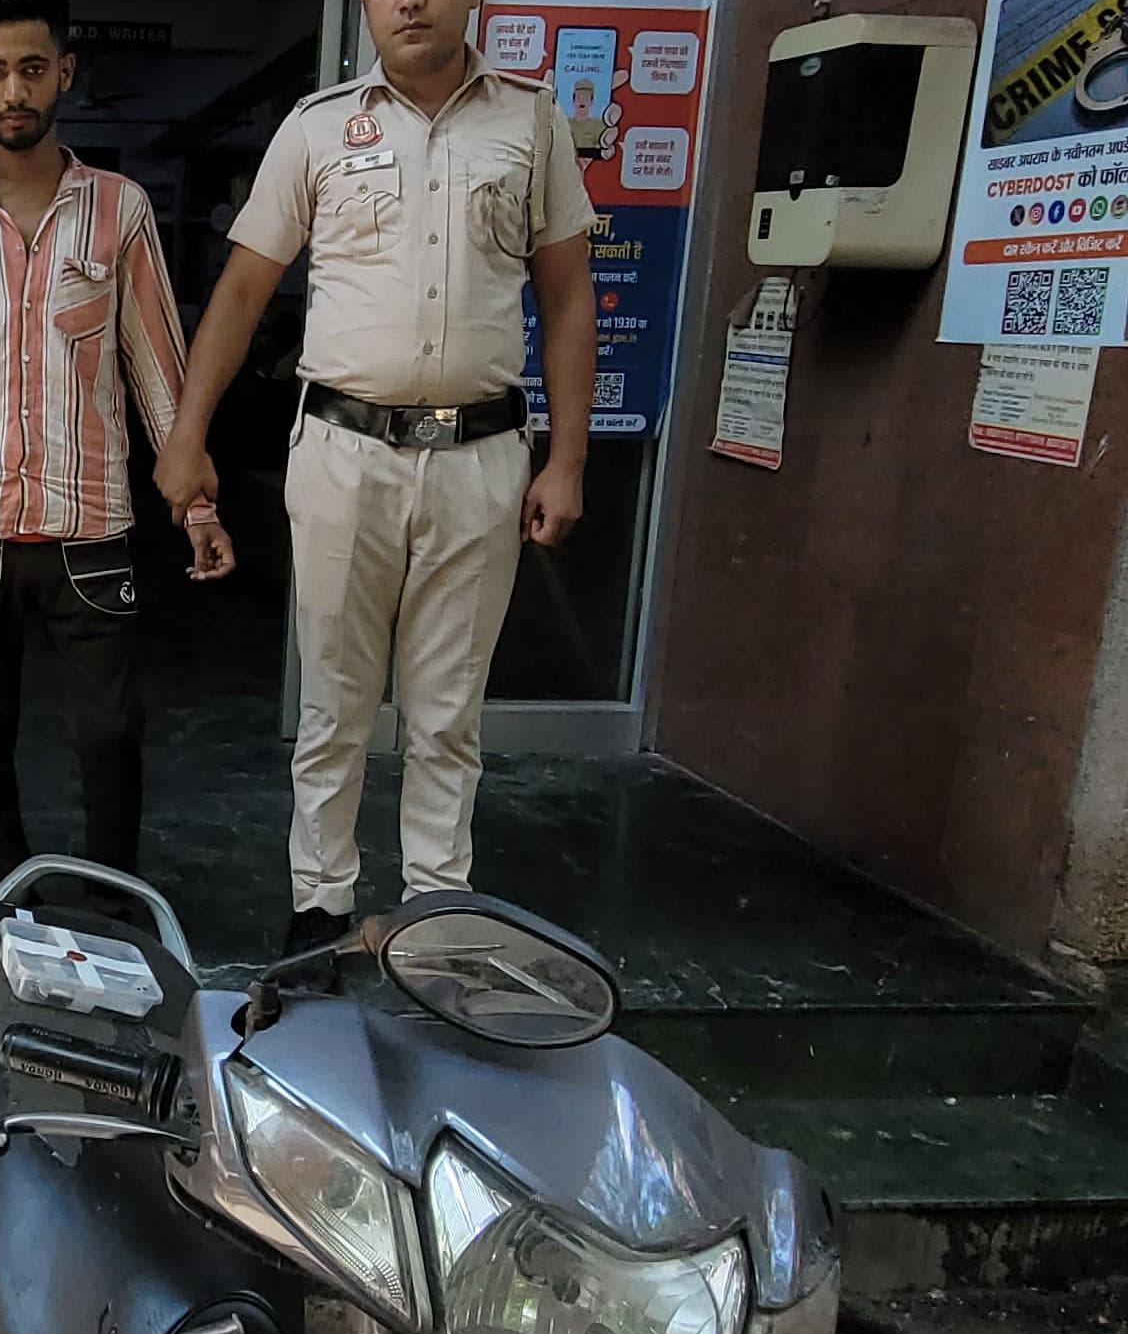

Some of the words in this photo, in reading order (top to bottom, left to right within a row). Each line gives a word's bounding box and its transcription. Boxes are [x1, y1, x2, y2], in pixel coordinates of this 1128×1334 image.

[989, 29, 1091, 132] CRIME
[987, 172, 1075, 199] CYBERDOST
[1077, 164, 1097, 188] को
[614, 316, 637, 329] 1930
